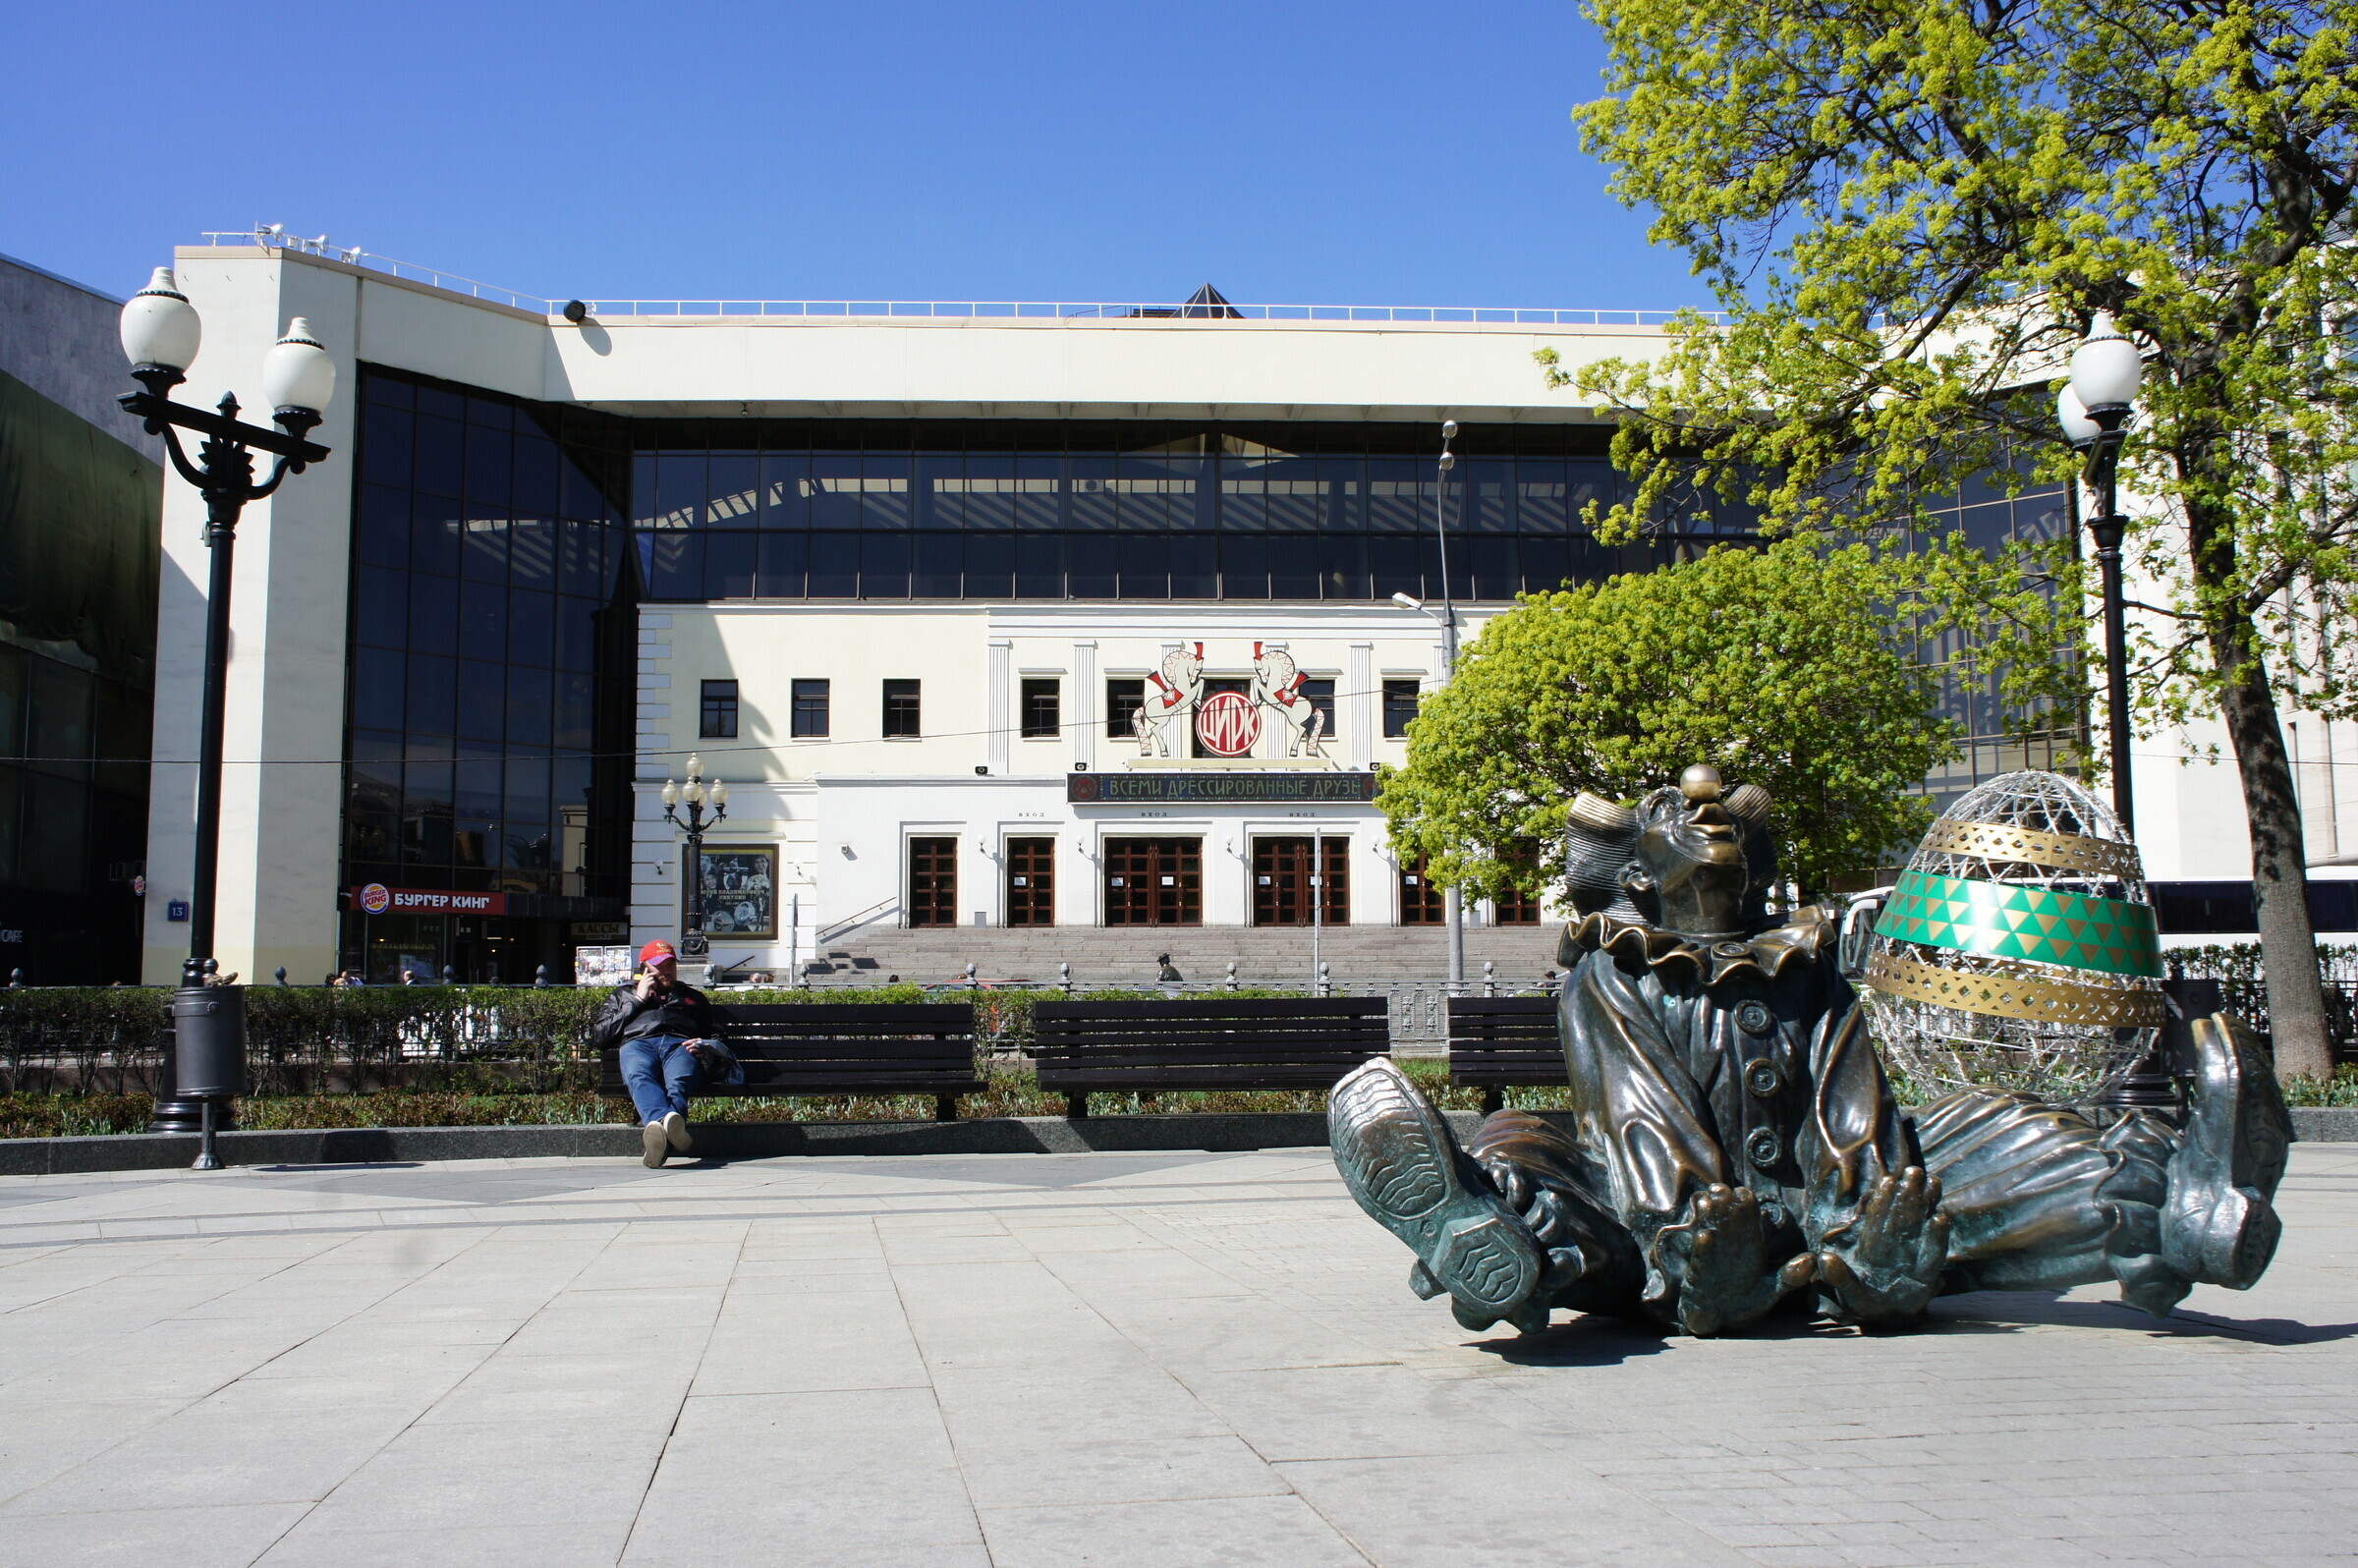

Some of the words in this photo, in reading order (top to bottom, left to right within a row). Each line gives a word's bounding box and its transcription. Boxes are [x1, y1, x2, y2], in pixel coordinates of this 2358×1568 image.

[1203, 696, 1257, 752] ЦИРК
[1109, 780, 1161, 796] ВСЕМИ
[1166, 779, 1308, 798] ДРЕССИРОВАННЫЕ
[364, 889, 386, 898] BURGER
[365, 894, 387, 907] KING
[394, 893, 449, 908] БУРГЕР
[452, 895, 490, 909] КИНГ
[172, 907, 183, 917] 13
[578, 924, 621, 933] КАССЫ
